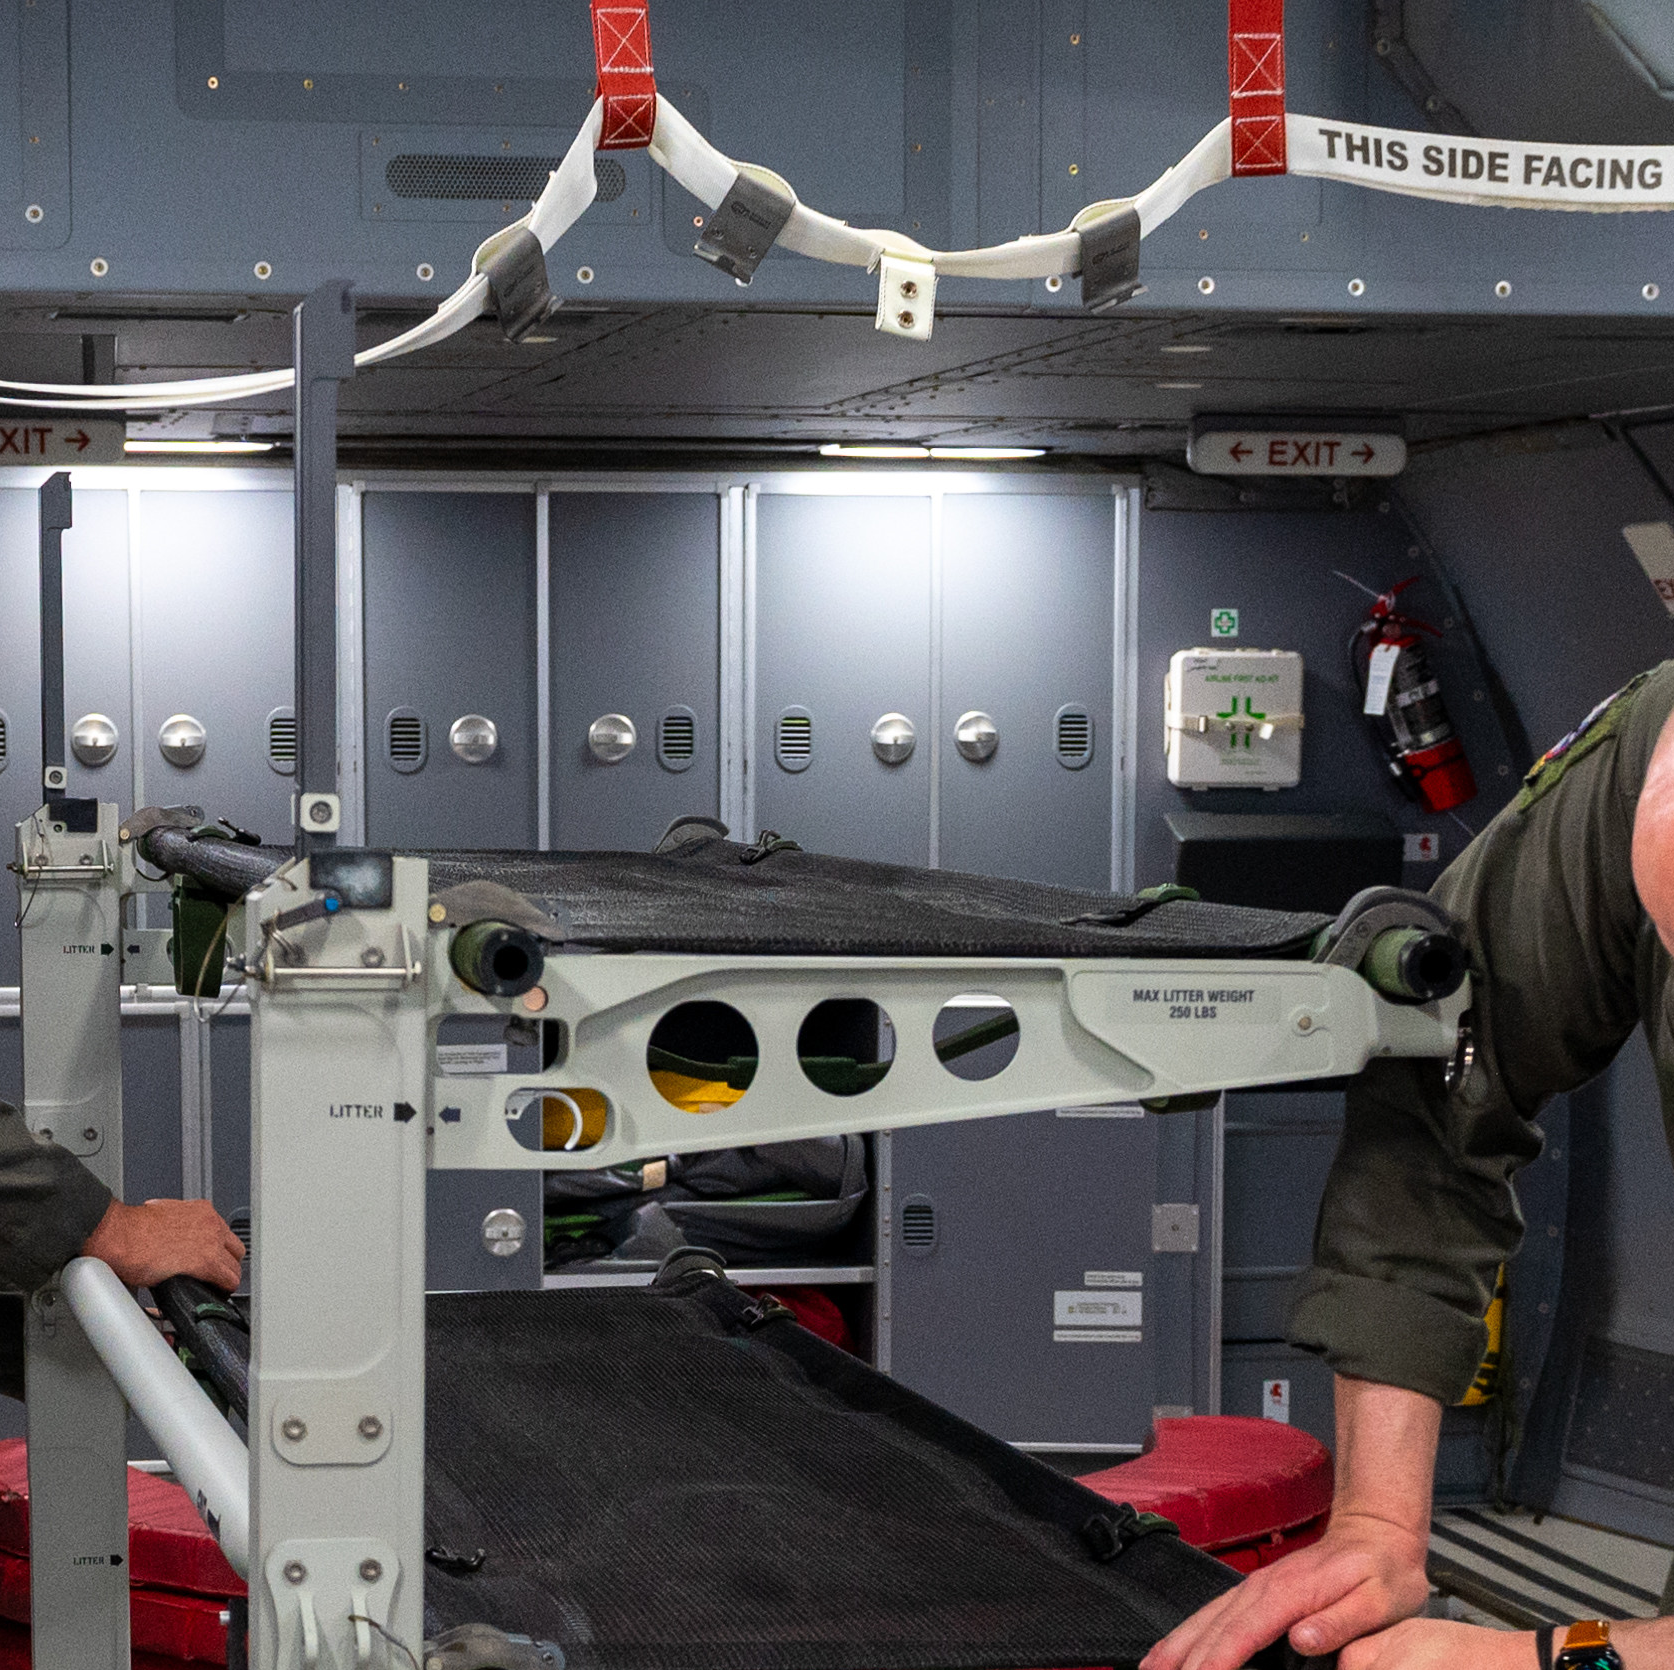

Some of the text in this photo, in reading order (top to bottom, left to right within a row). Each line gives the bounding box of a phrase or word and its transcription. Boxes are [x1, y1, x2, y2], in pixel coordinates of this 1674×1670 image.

[1319, 129, 1409, 171] THIS
[1422, 145, 1509, 183] SIDE
[1524, 154, 1663, 190] FACING
[1268, 441, 1341, 466] EXIT
[63, 945, 95, 954] LITTER
[1133, 989, 1255, 1002] MAX LITTER WEIGHT
[1169, 1006, 1217, 1019] 250 LBS
[329, 1104, 383, 1119] LITTER
[73, 1556, 105, 1566] LITTER
